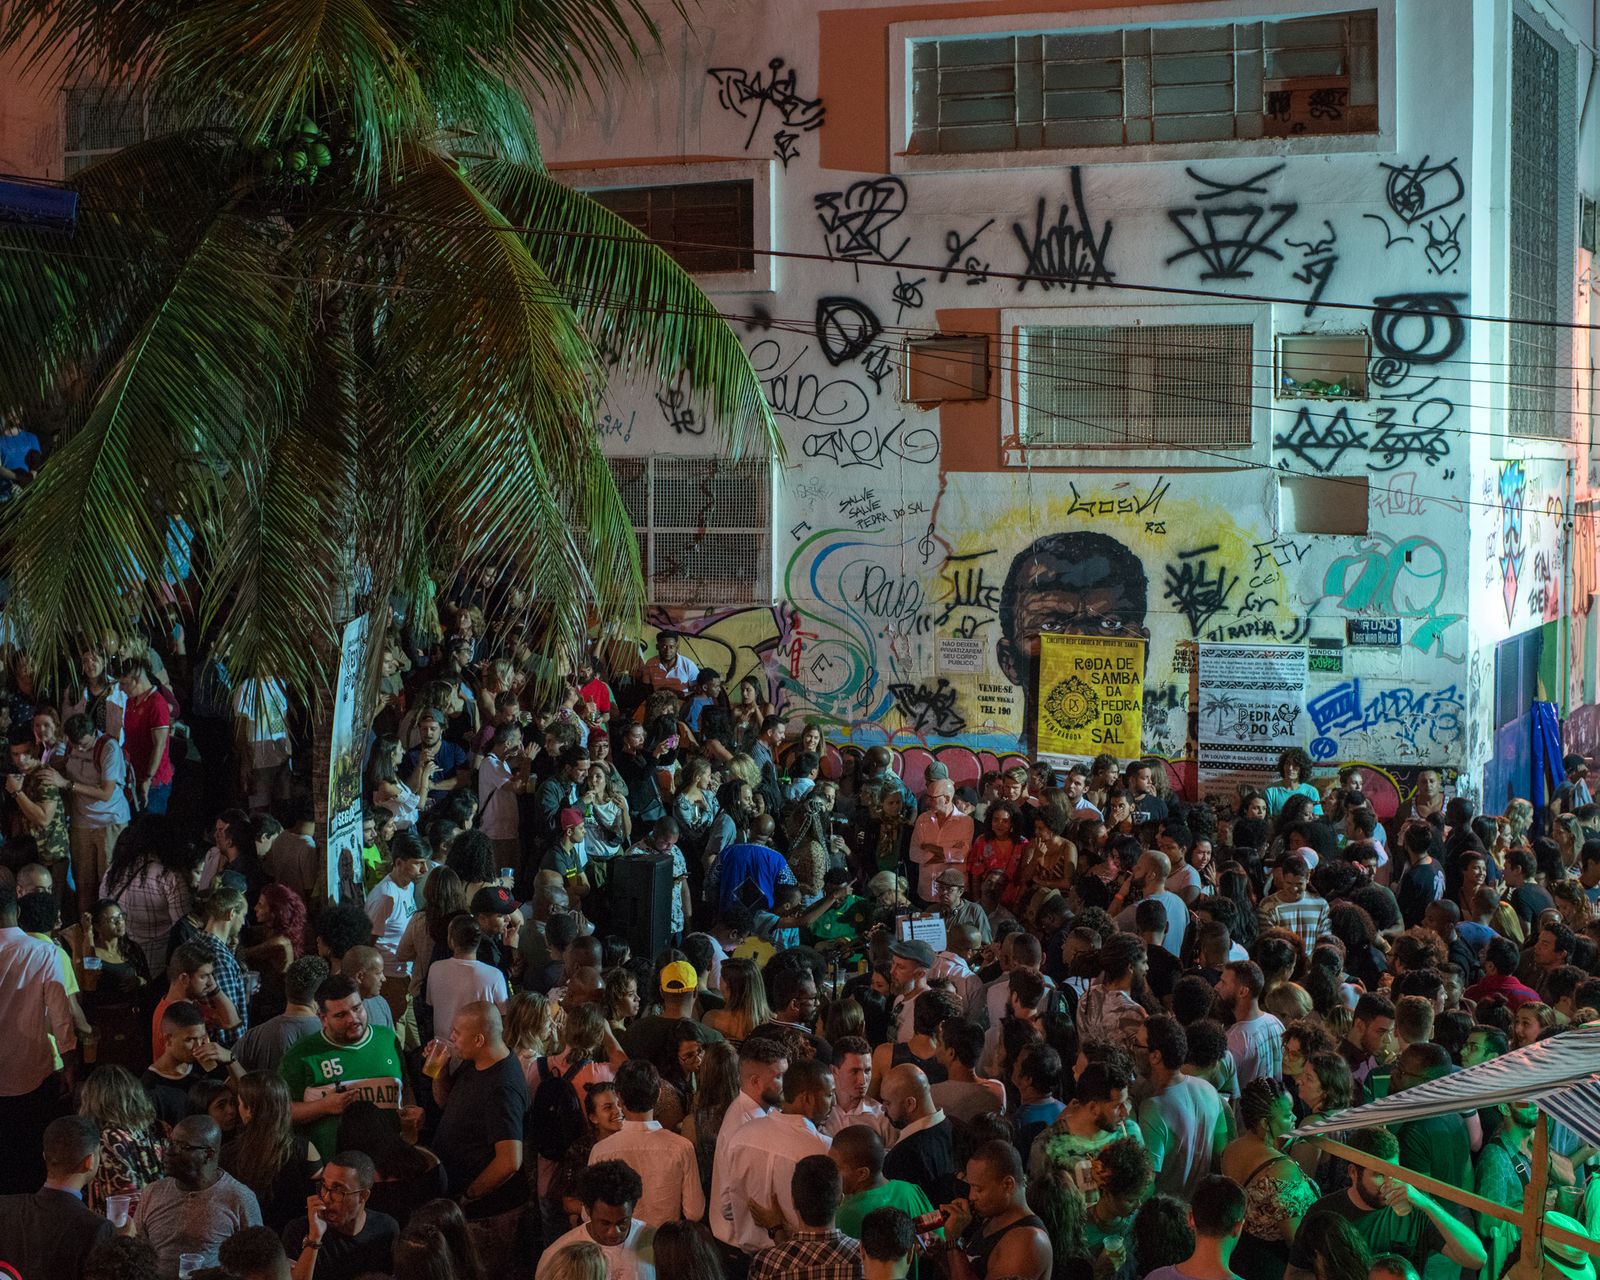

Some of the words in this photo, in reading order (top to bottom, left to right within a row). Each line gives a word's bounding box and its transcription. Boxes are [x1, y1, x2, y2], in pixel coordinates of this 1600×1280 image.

[839, 487, 875, 513] SALVE
[849, 500, 881, 519] SALVE
[856, 511, 892, 529] PEDRA
[893, 508, 905, 519] DO
[907, 501, 931, 514] SAL
[1074, 657, 1112, 670] RODA
[1116, 657, 1134, 670] DE
[1091, 672, 1140, 684] SAMBA
[979, 684, 1013, 693] VENDE-SE
[1106, 686, 1122, 696] DA
[980, 705, 996, 714] TEL:
[998, 706, 1011, 715] 190
[1101, 700, 1140, 711] PEDRA
[1104, 713, 1122, 726] DO
[1239, 708, 1280, 723] PEDRA
[1091, 728, 1124, 744] SAL
[1251, 724, 1268, 735] DO
[1272, 722, 1295, 737] SAL
[321, 1057, 343, 1079] 85
